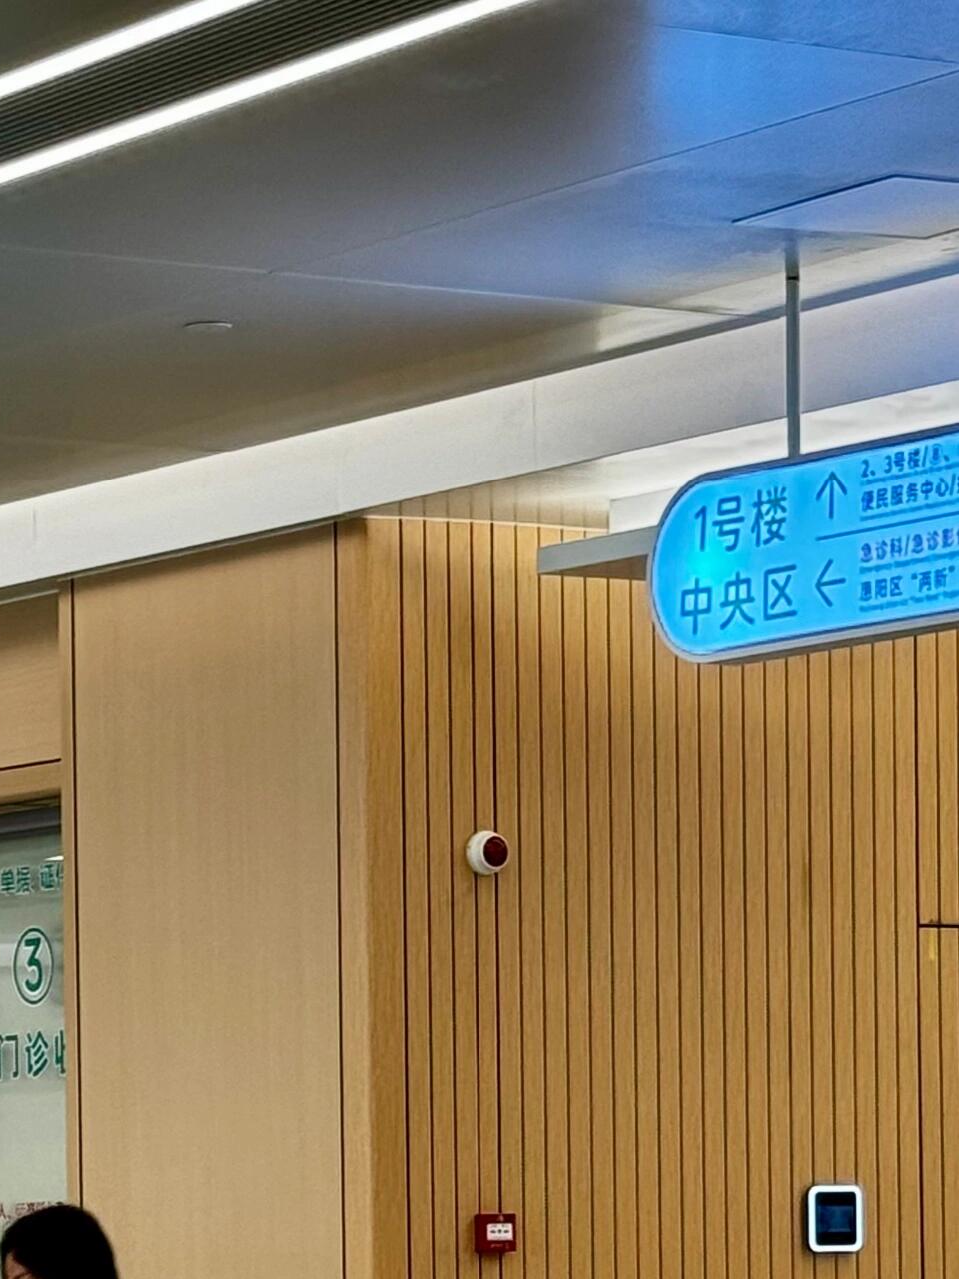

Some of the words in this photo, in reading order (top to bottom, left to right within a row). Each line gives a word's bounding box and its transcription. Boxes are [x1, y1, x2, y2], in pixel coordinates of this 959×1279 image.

[693, 485, 788, 552] 1号楼
[861, 473, 959, 513] 便民服务中心/
[860, 527, 959, 563] 急诊科/急诊影
[680, 564, 798, 636] 中央区
